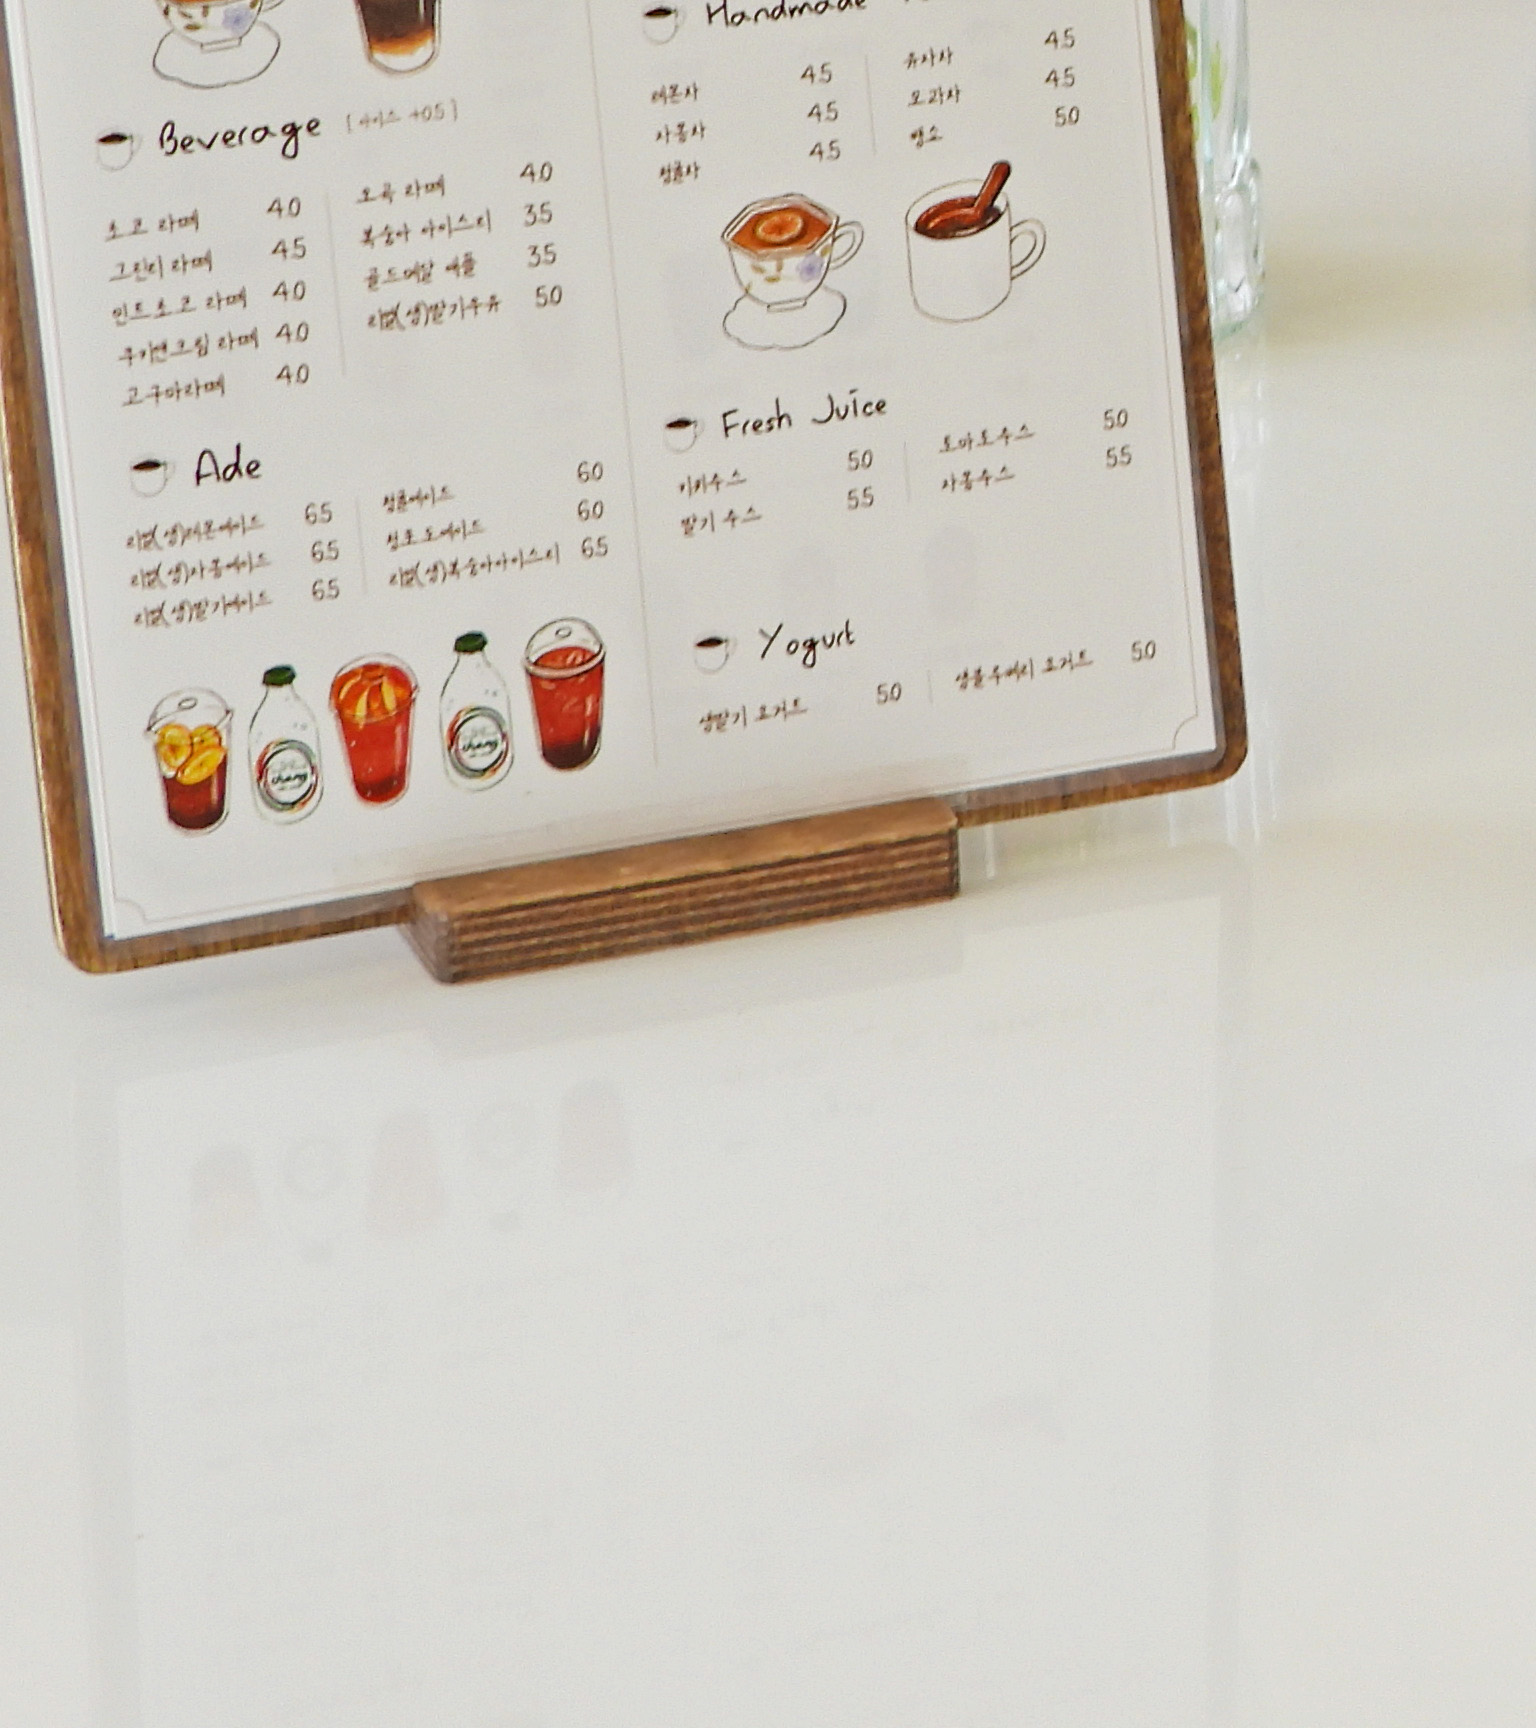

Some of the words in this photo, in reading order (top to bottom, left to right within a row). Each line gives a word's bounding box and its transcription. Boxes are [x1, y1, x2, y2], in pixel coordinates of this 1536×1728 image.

[157, 116, 321, 161] Beverage
[720, 396, 792, 439] Fresh
[810, 388, 887, 425] Juice
[194, 441, 262, 487] Ade
[757, 617, 855, 669] Yogurt
